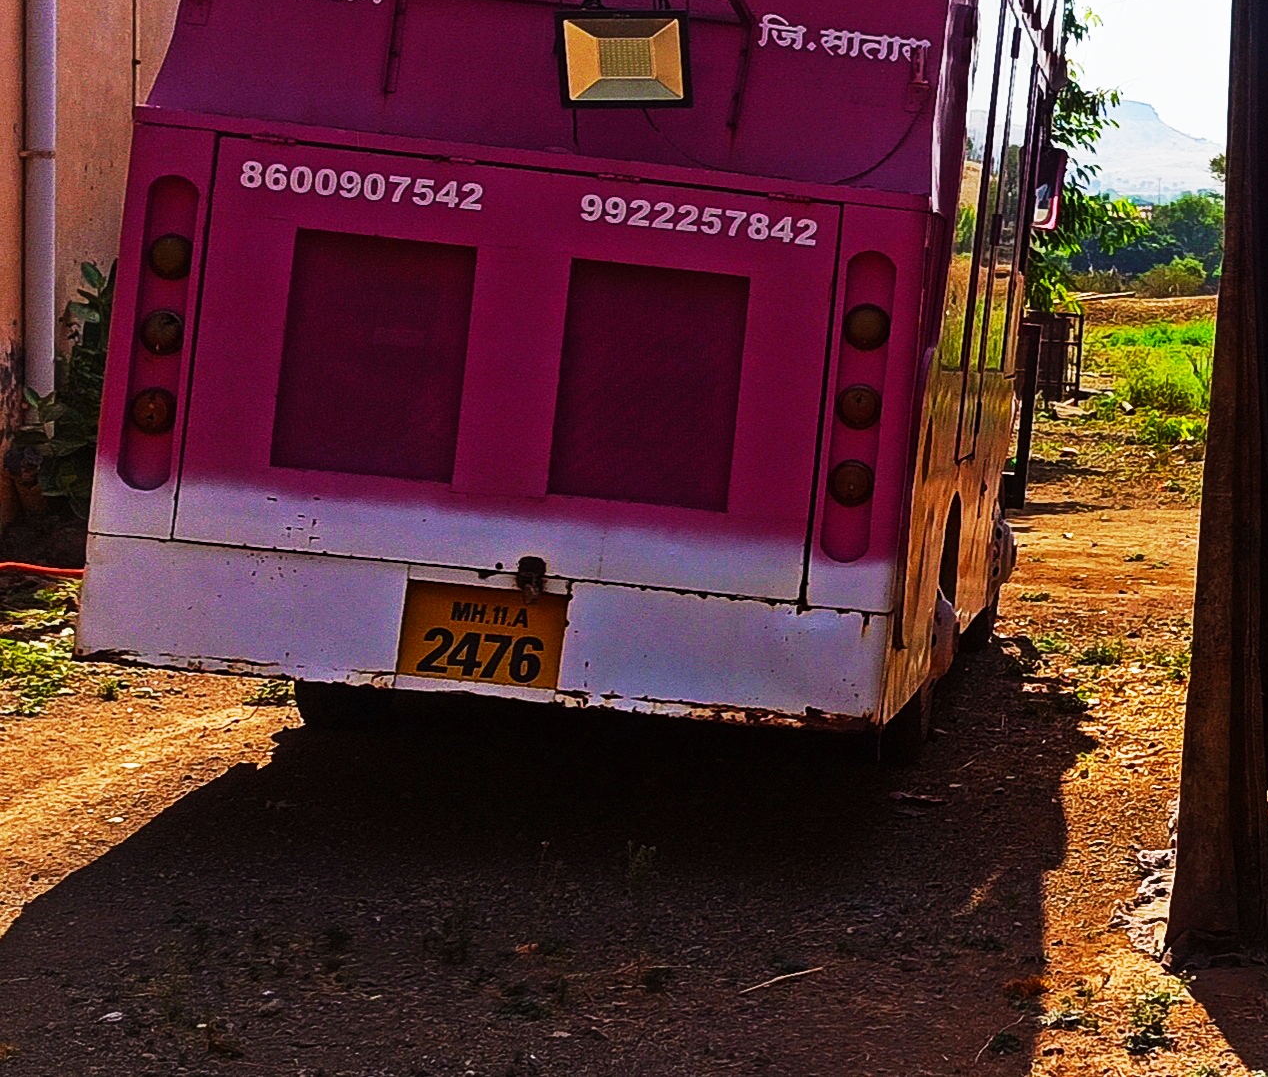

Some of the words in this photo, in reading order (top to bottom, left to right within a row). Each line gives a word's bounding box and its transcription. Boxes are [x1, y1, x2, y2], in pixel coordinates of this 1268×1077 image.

[239, 160, 484, 211] 8600907542
[579, 194, 818, 246] 9922257842
[450, 601, 529, 629] MH.11.A
[416, 627, 545, 684] 2476
